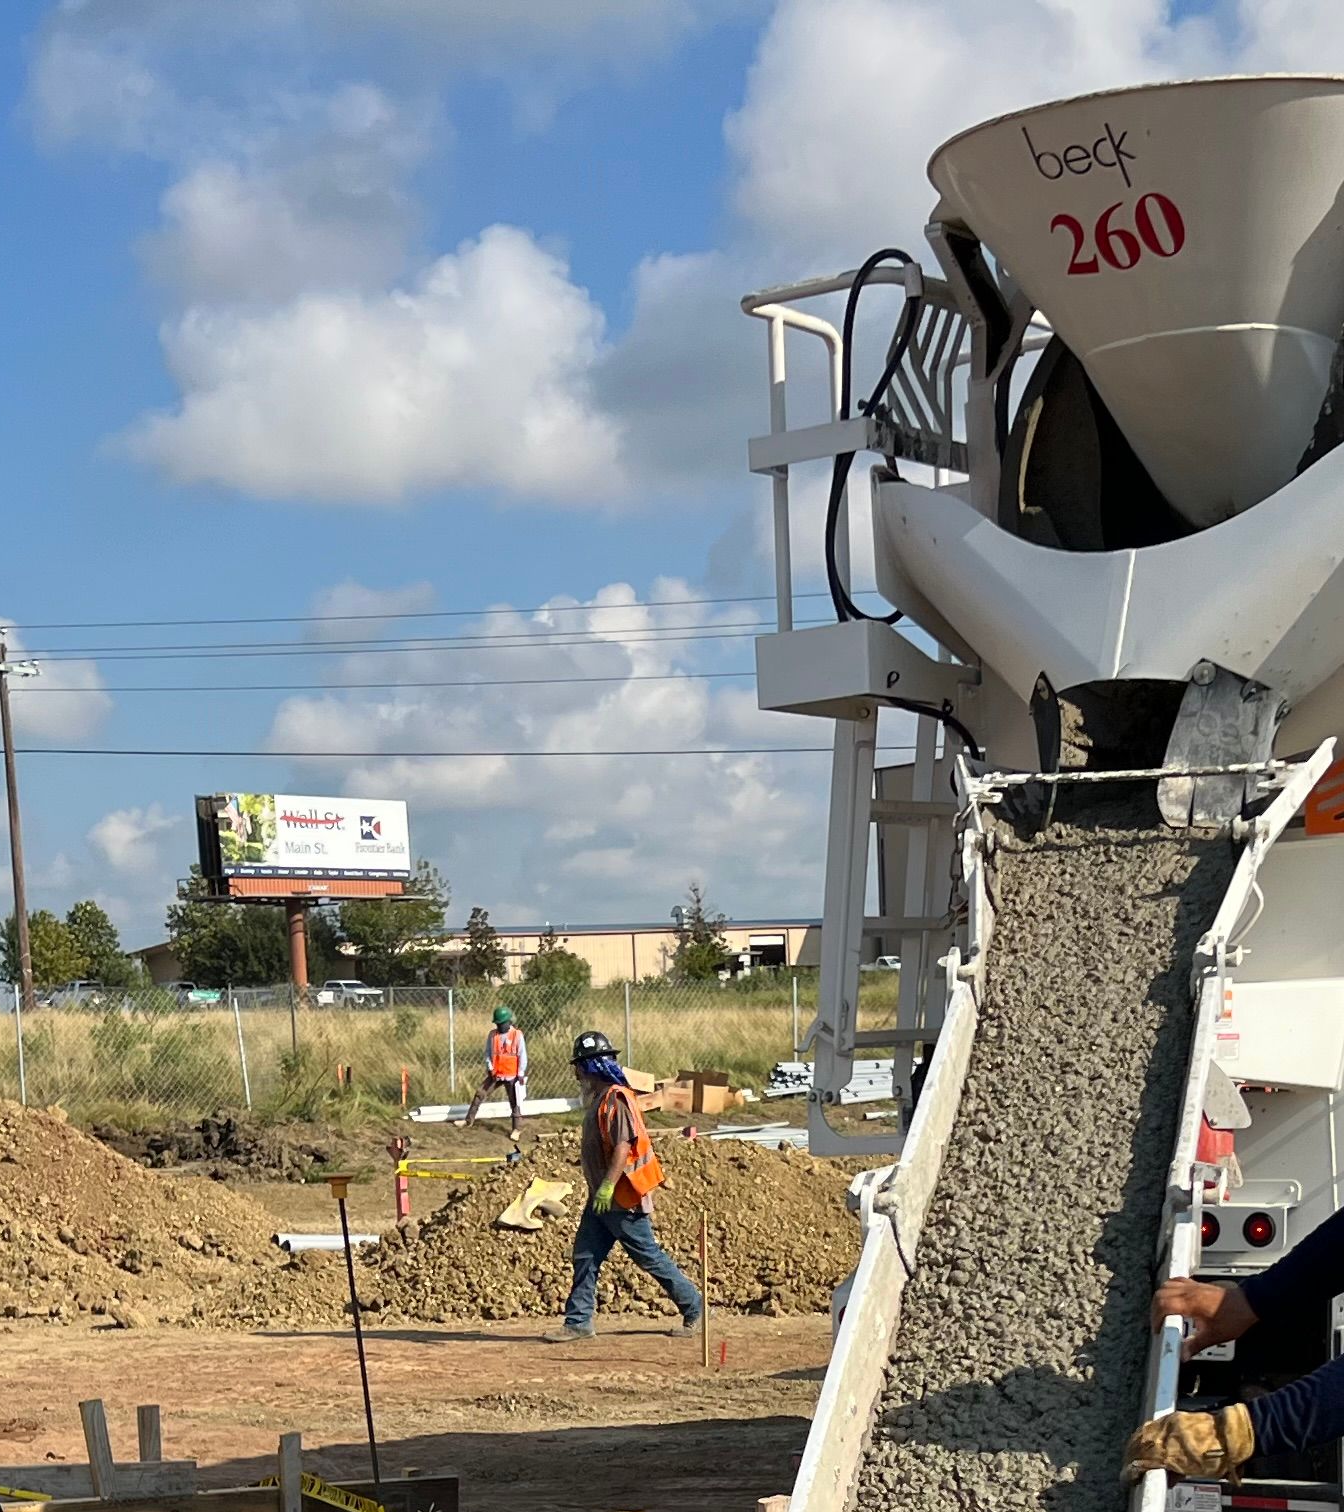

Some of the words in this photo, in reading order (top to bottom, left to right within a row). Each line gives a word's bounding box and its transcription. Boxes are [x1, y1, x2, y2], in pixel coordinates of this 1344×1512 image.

[1022, 122, 1136, 188] beck
[1050, 192, 1185, 275] 260
[282, 808, 318, 829] Wall
[324, 811, 346, 831] St.
[285, 841, 311, 854] Main
